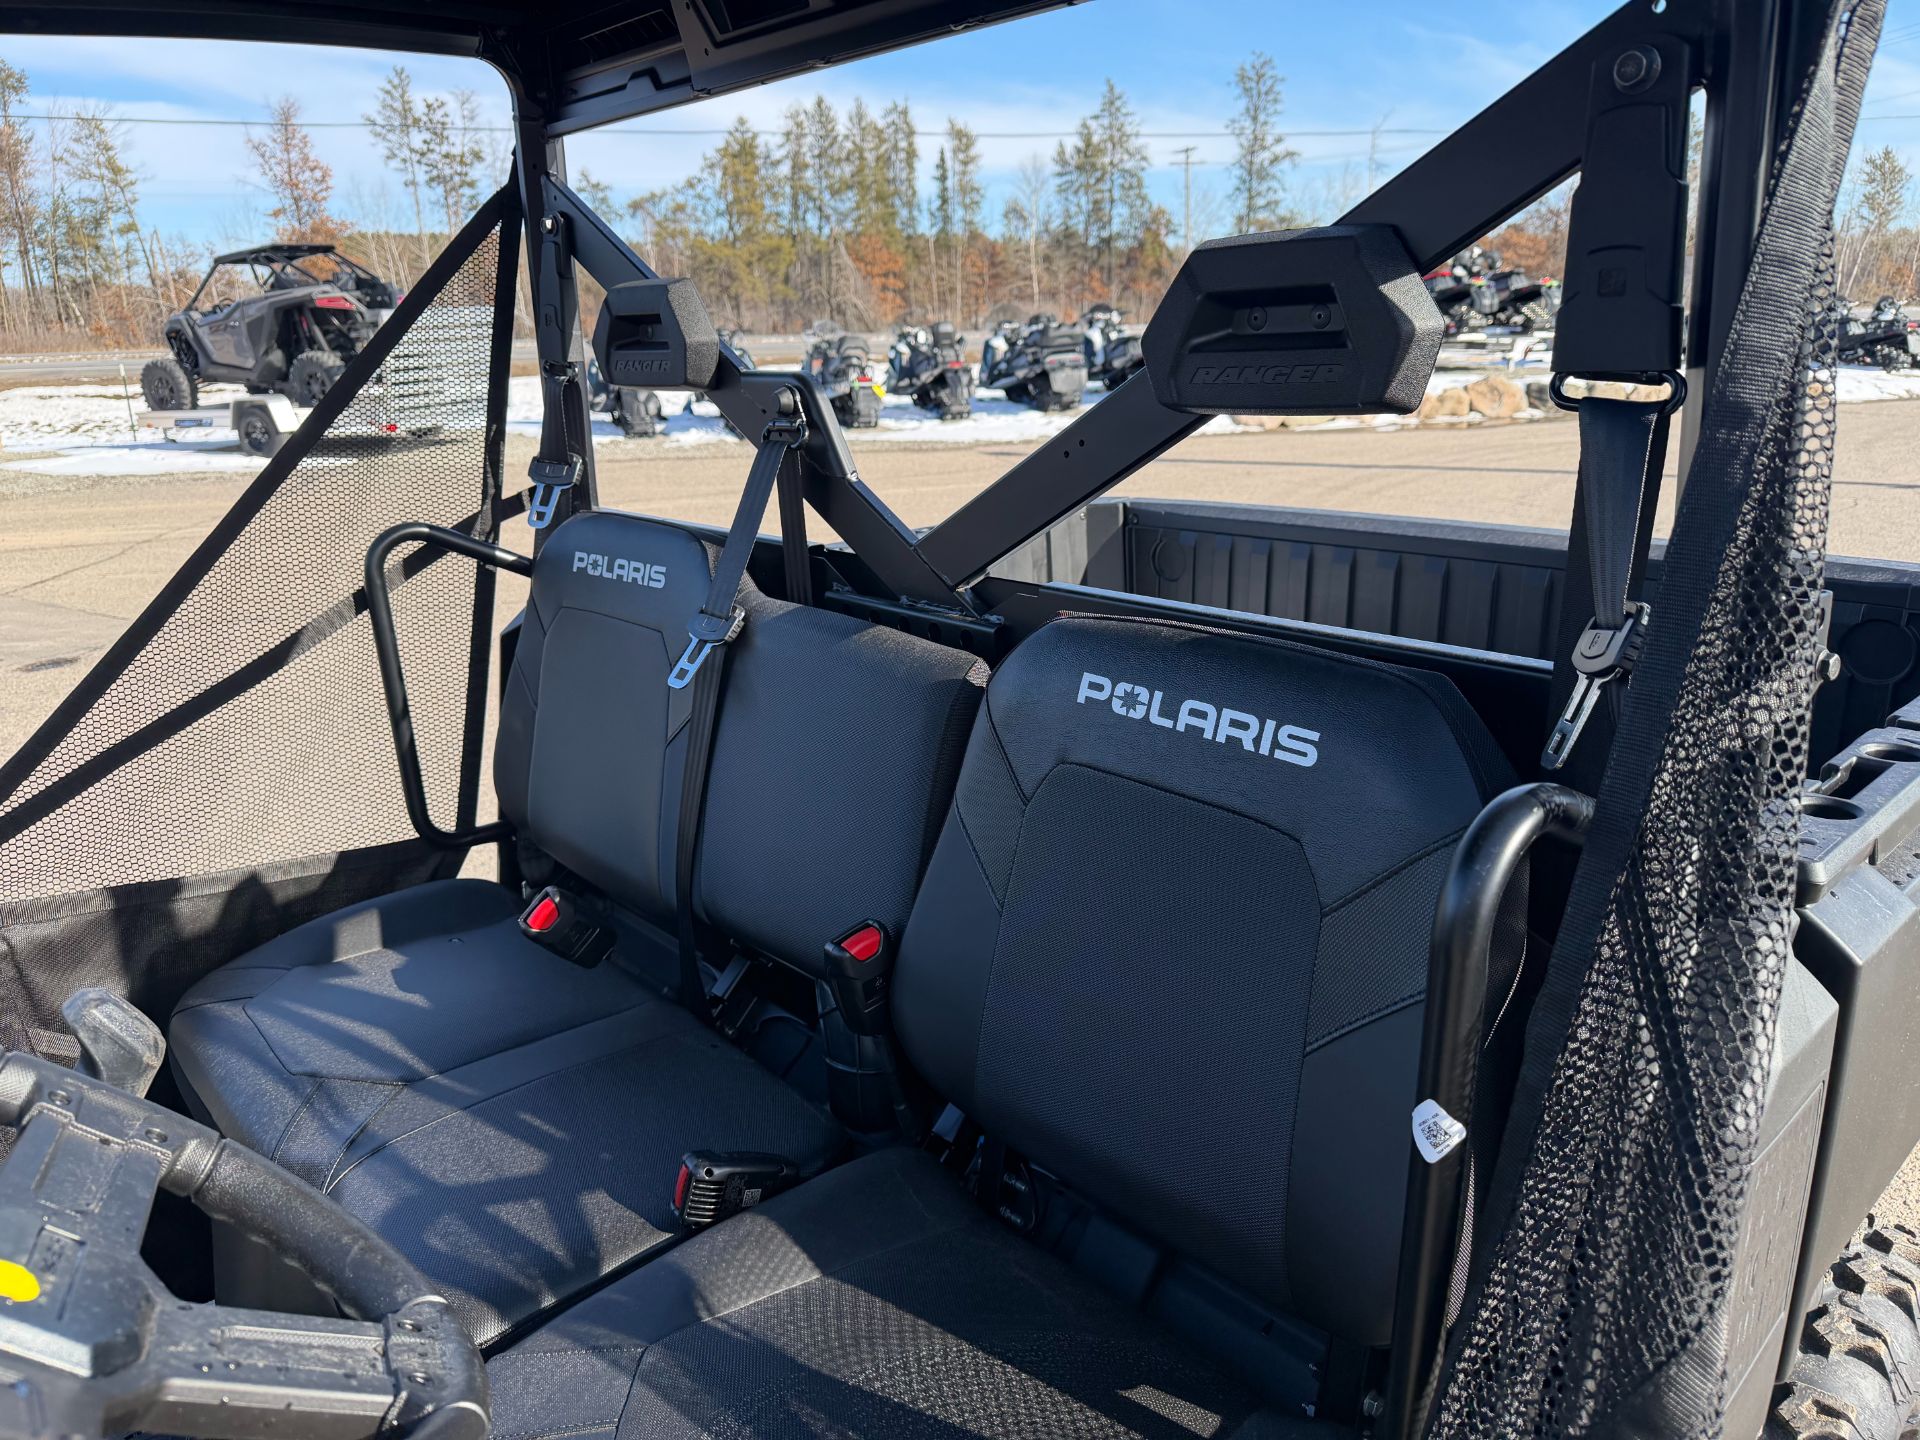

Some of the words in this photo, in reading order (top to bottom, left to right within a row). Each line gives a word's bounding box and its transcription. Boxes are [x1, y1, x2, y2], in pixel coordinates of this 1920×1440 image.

[614, 358, 671, 374] RANGER
[1189, 363, 1345, 385] RANGER
[572, 551, 667, 589] POLARIS
[1076, 671, 1321, 767] POLARIS
